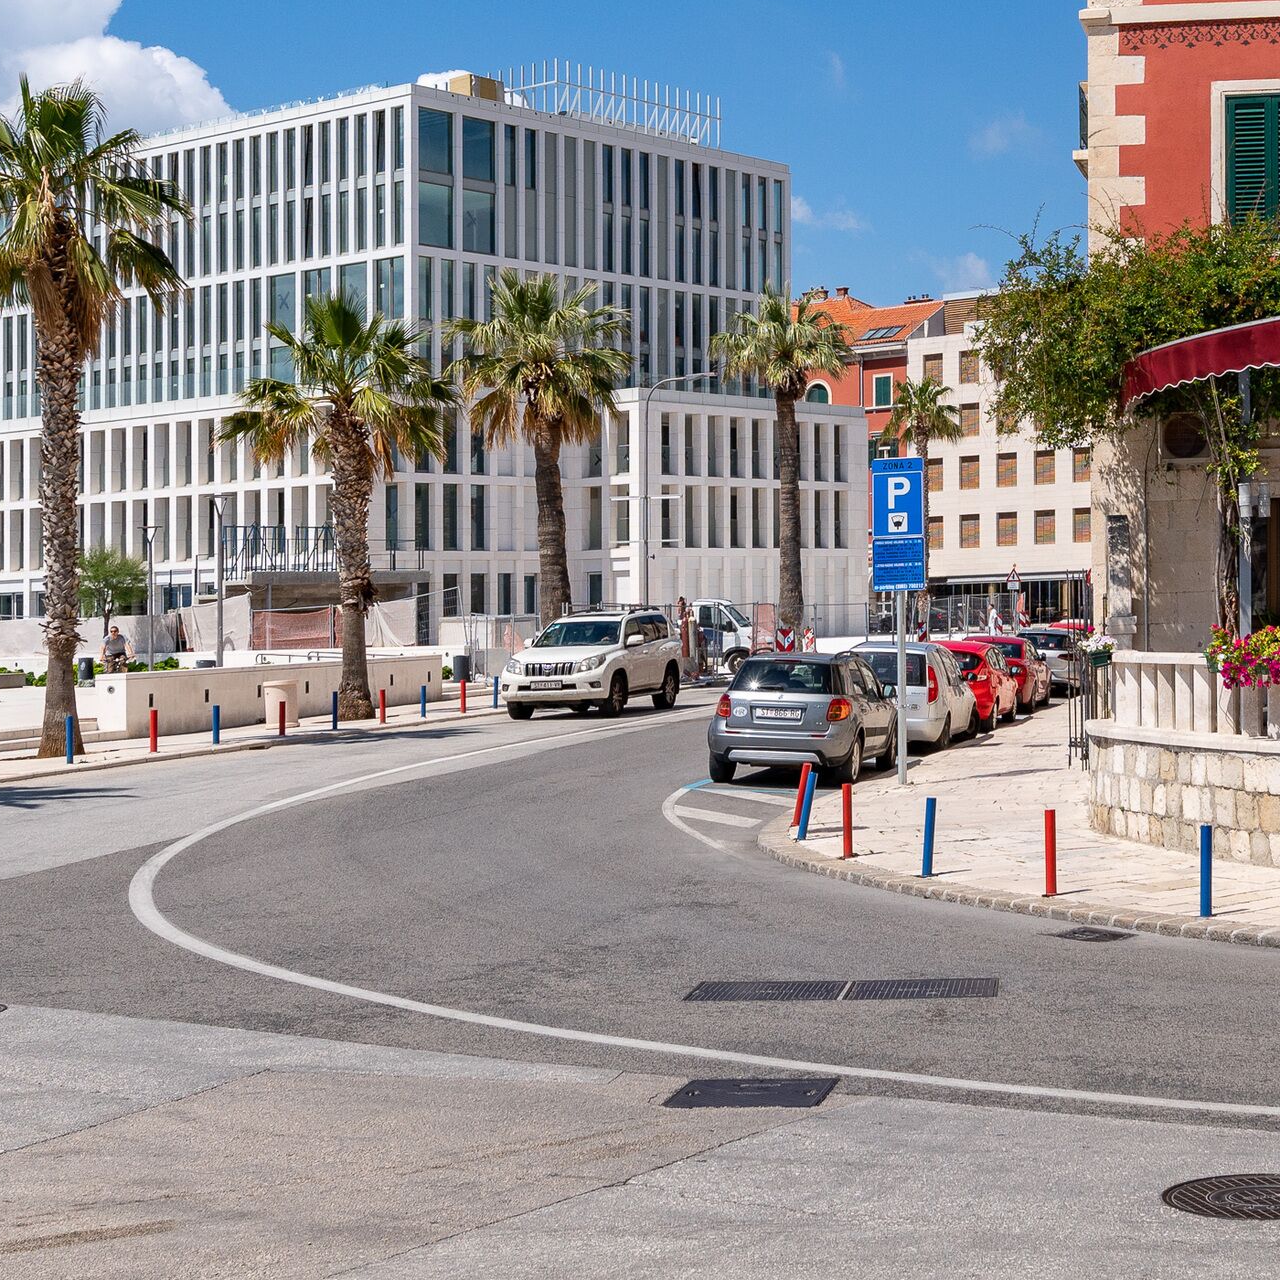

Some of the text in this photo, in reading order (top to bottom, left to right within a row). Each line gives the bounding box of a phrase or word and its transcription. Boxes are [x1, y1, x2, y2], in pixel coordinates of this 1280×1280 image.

[882, 461, 913, 471] ZONA 2
[887, 476, 911, 510] P
[761, 707, 769, 716] ST
